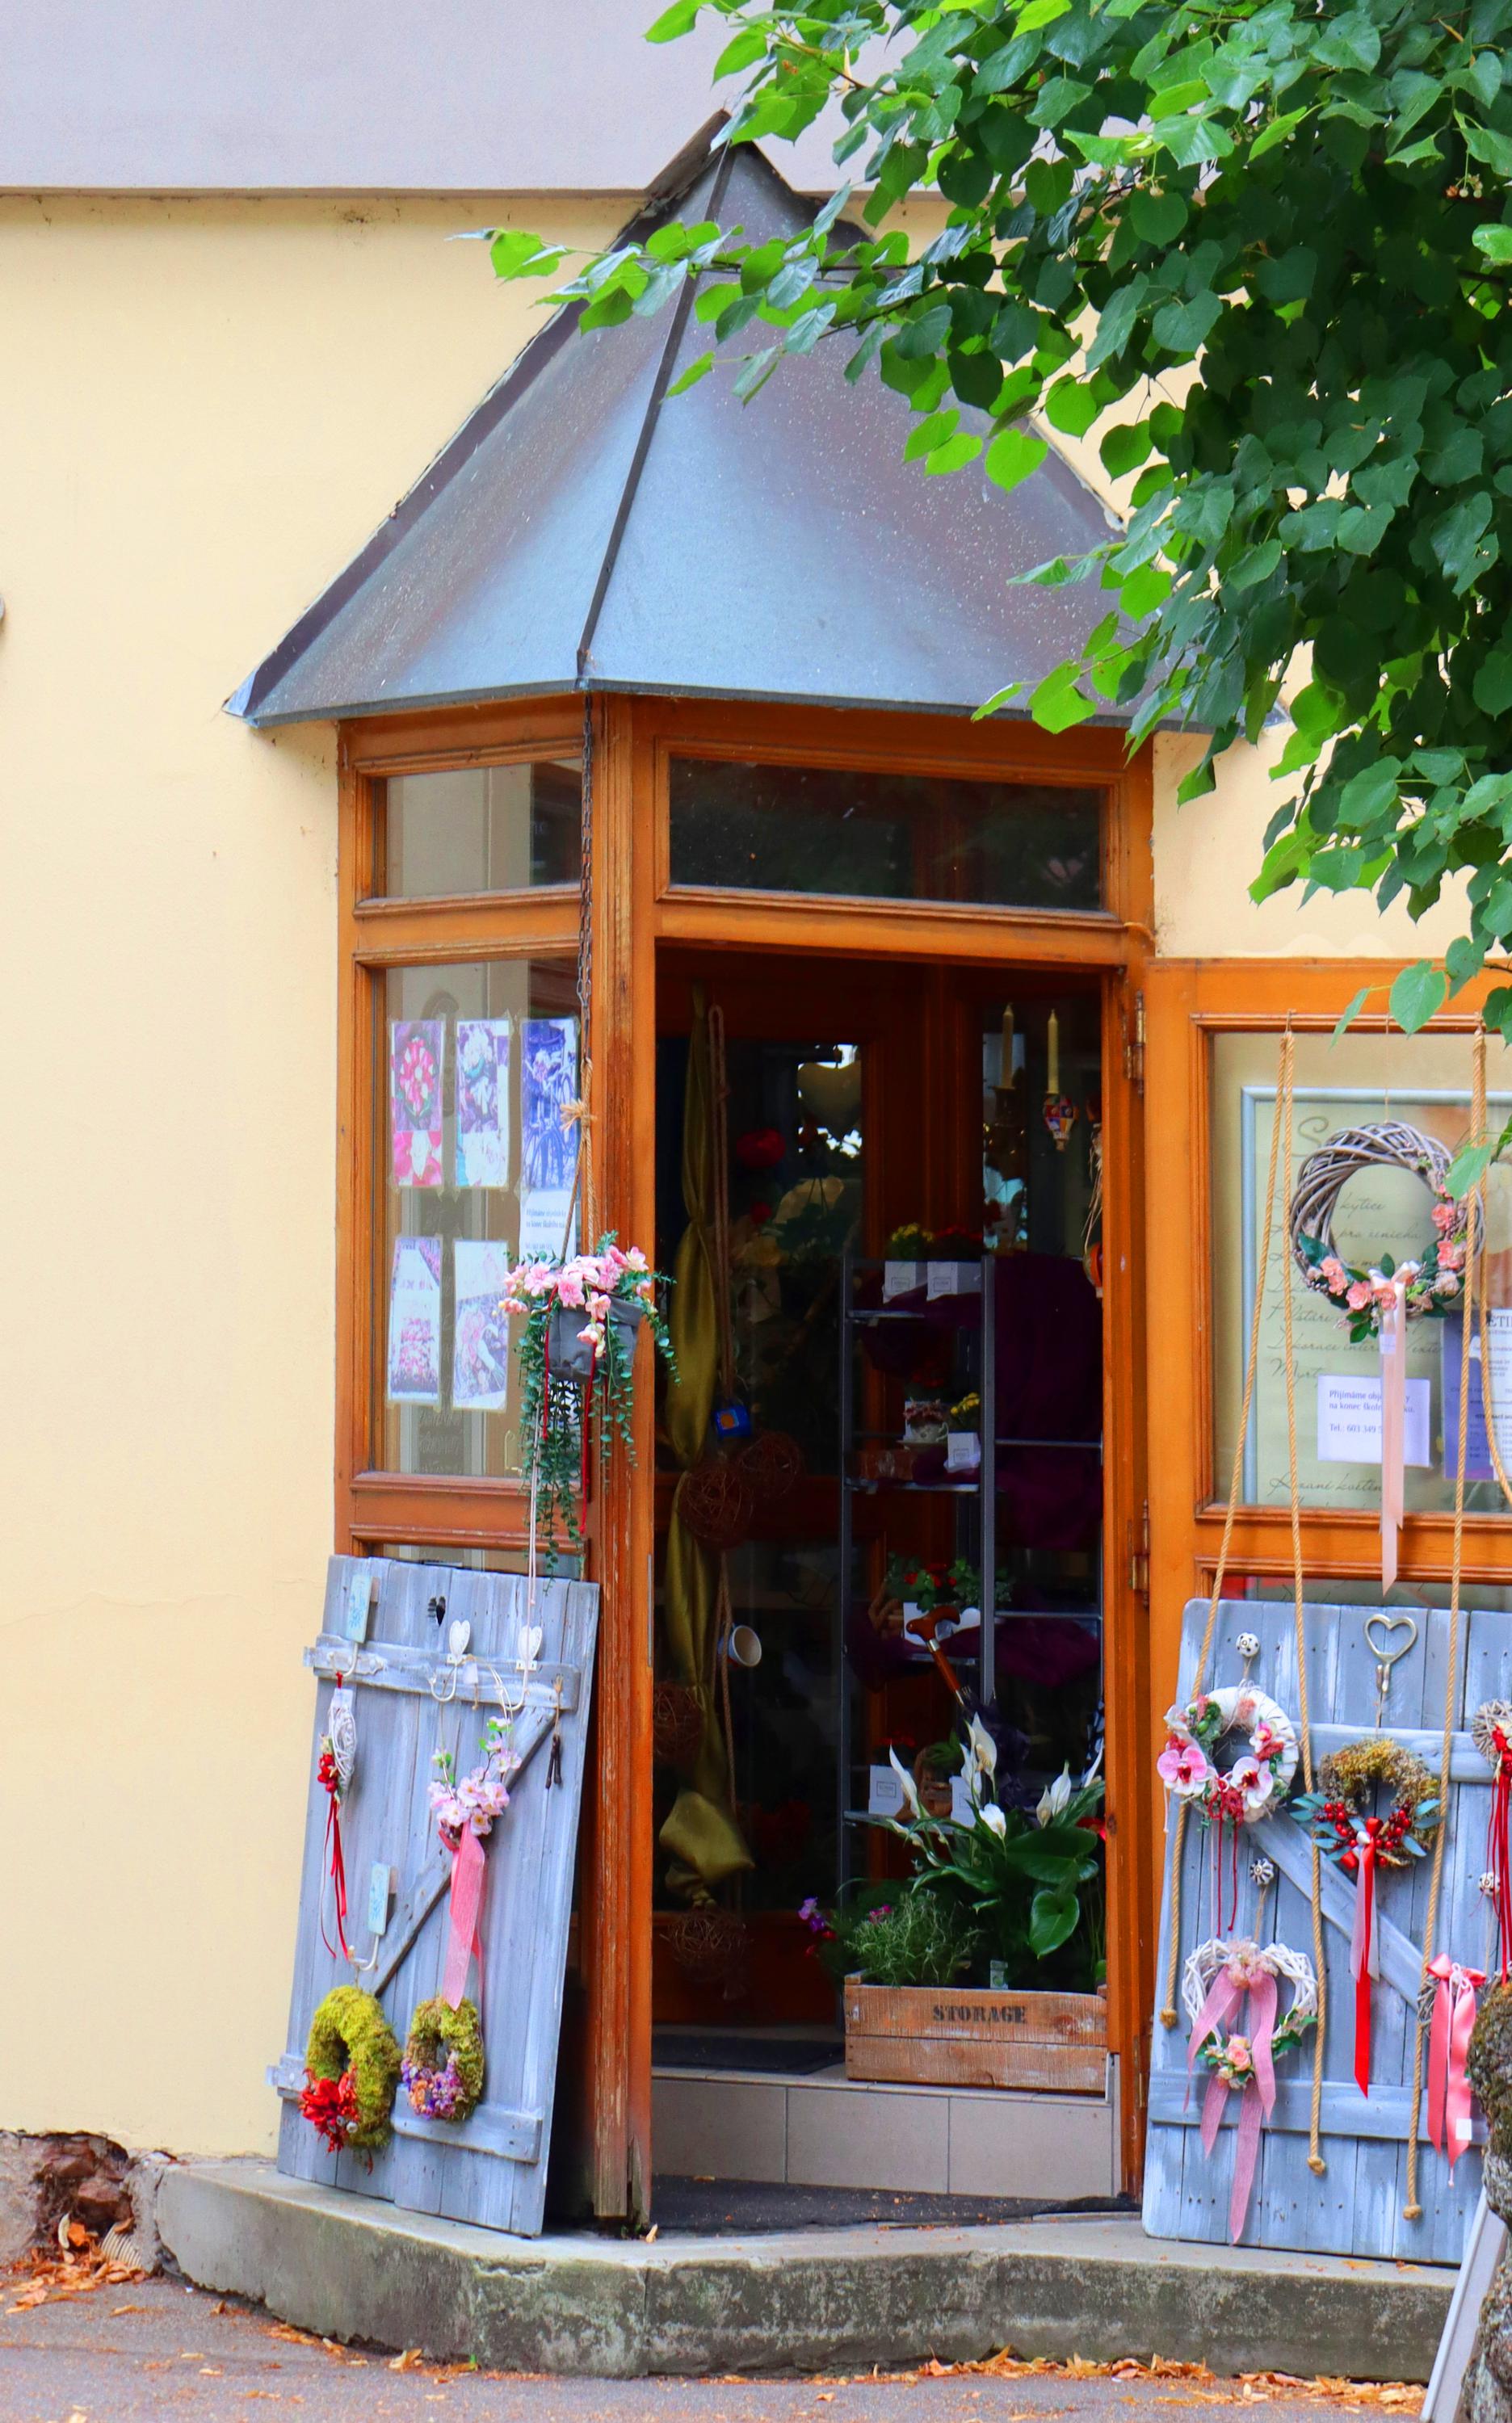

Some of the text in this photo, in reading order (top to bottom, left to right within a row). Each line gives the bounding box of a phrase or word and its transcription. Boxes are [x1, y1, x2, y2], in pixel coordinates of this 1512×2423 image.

[1329, 1389, 1367, 1400] Přijímáme
[1339, 1402, 1362, 1410] konec
[932, 2005, 1028, 2025] STORAGE
